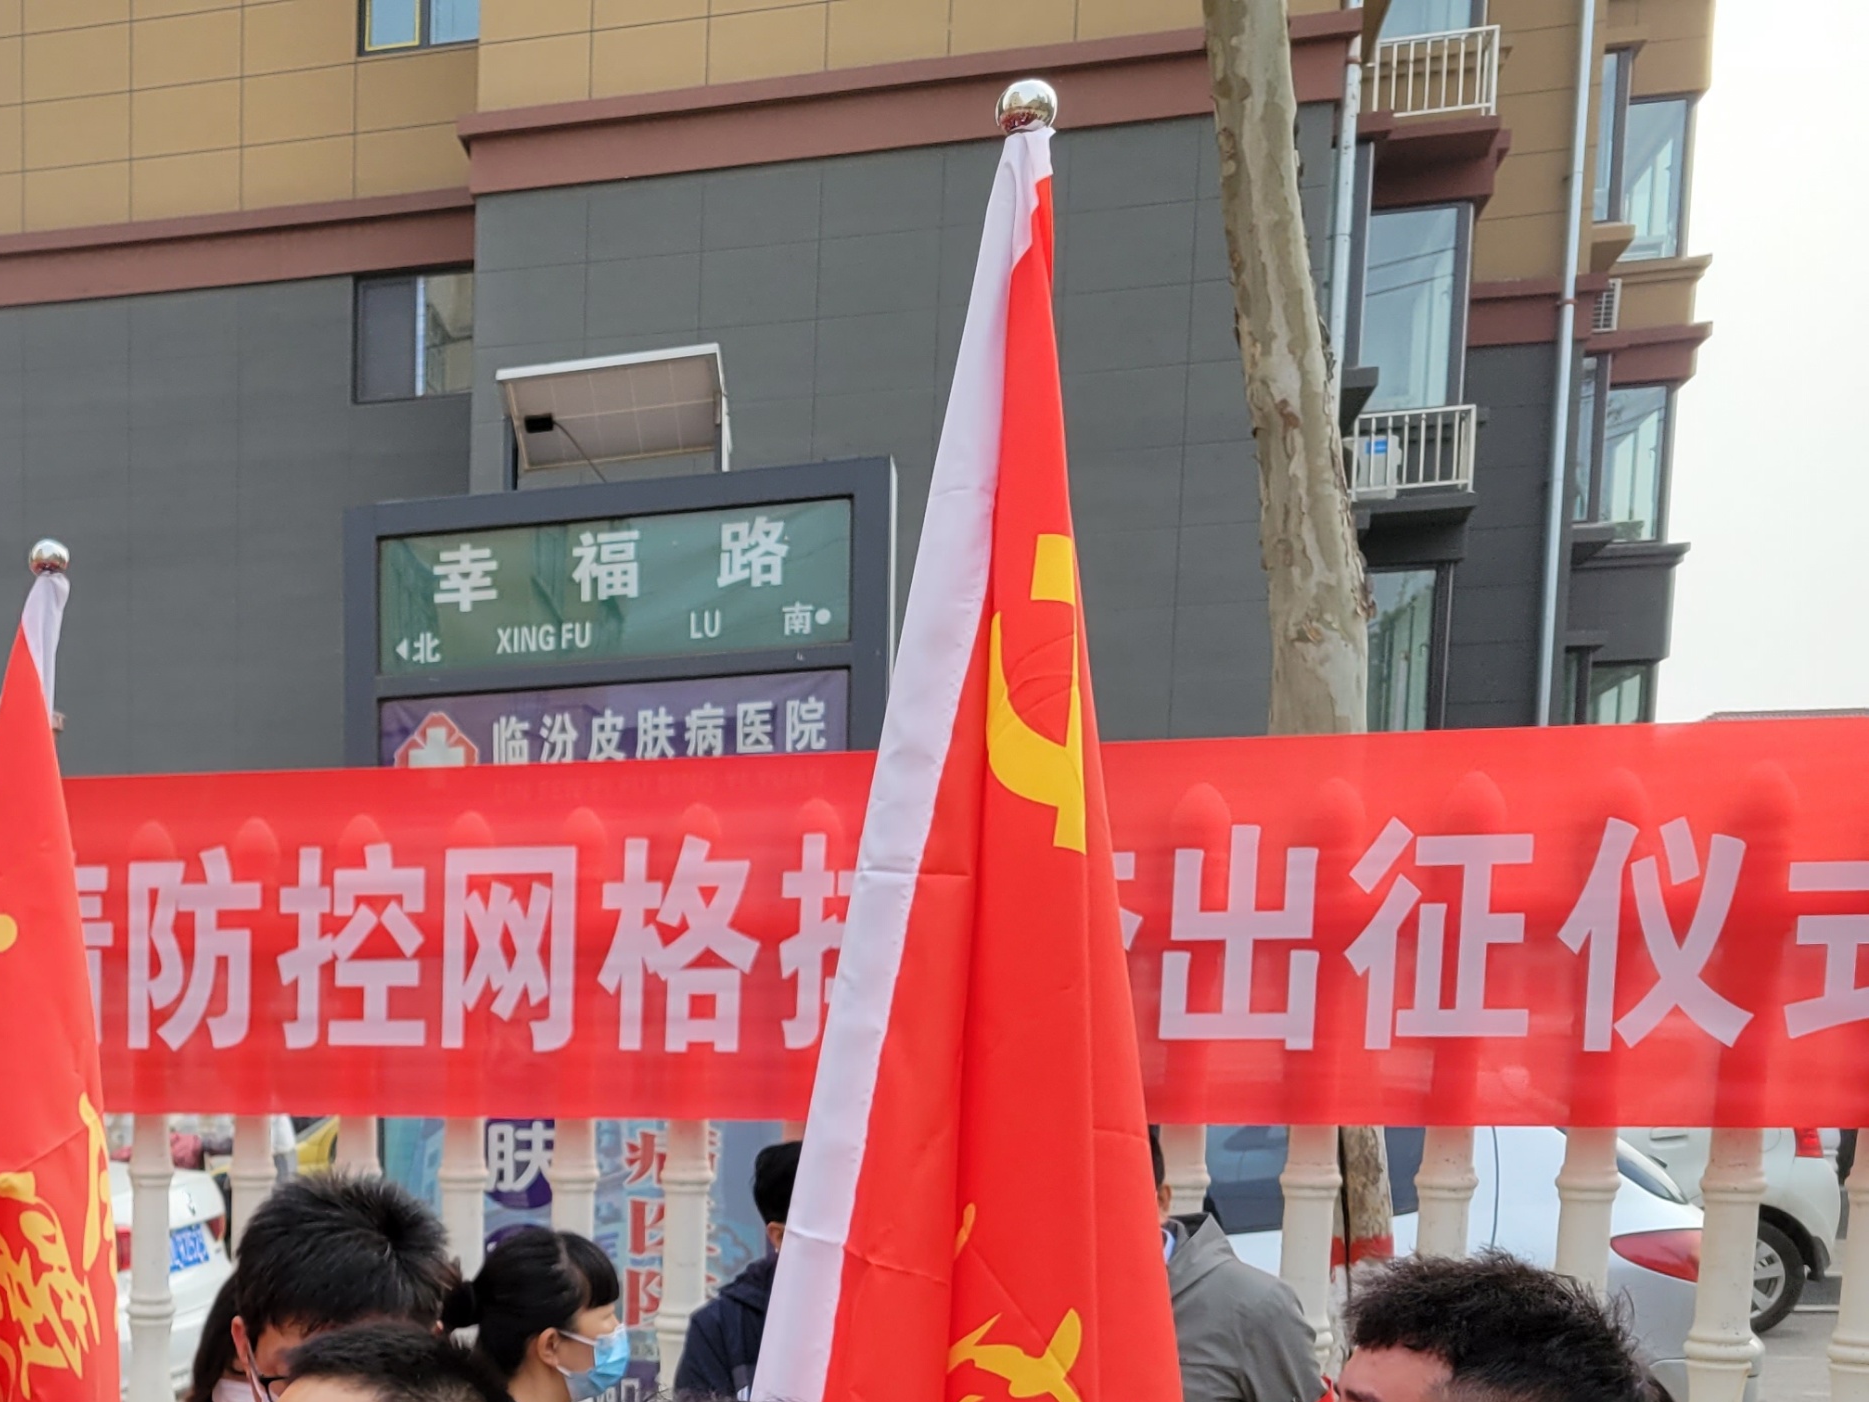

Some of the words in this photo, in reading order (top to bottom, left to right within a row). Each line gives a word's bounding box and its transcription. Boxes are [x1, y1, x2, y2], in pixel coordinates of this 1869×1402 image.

[433, 516, 790, 612] 幸福路
[690, 609, 720, 639] LU
[782, 603, 814, 635] 南
[414, 632, 442, 664] 北
[492, 696, 827, 766] 临汾皮肤病医院
